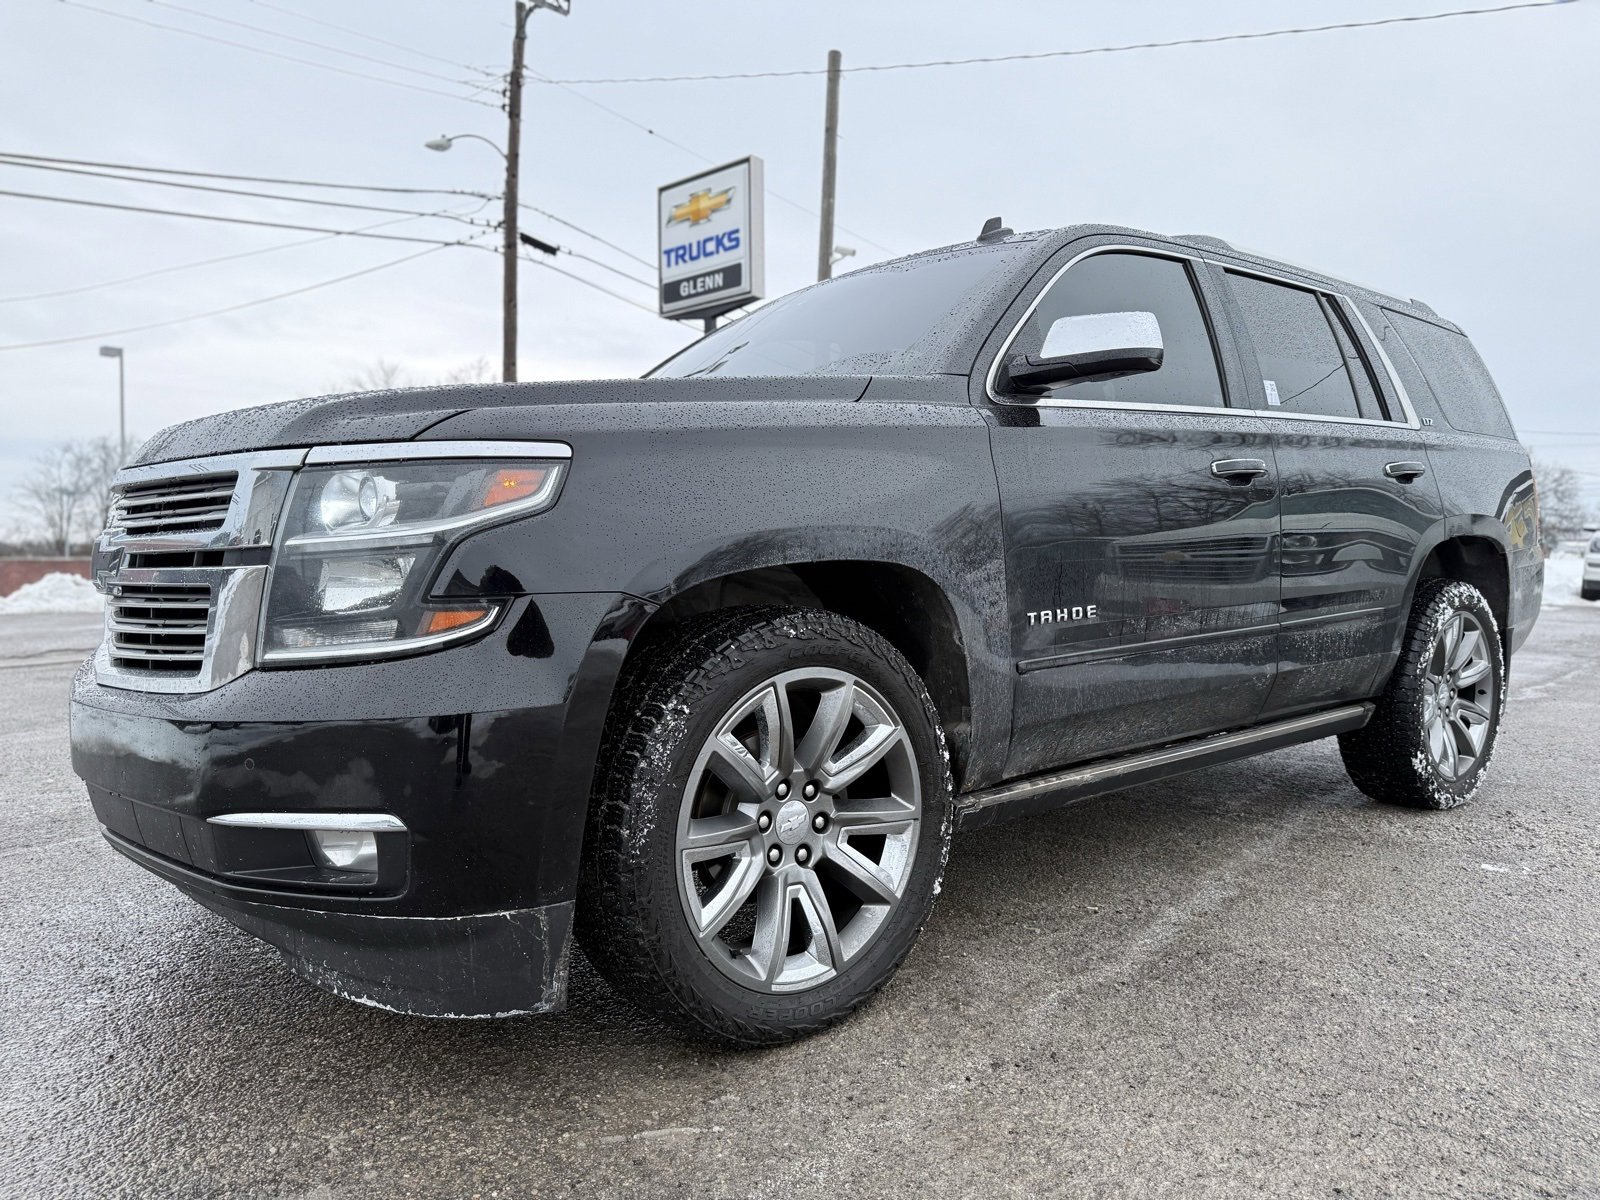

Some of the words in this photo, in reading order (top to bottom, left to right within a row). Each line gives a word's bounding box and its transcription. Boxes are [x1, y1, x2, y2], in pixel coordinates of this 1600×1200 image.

[663, 228, 740, 268] TRUCKS
[680, 272, 724, 297] GLENN
[1026, 604, 1097, 626] TAHOE
[746, 996, 838, 1022] COOPER
